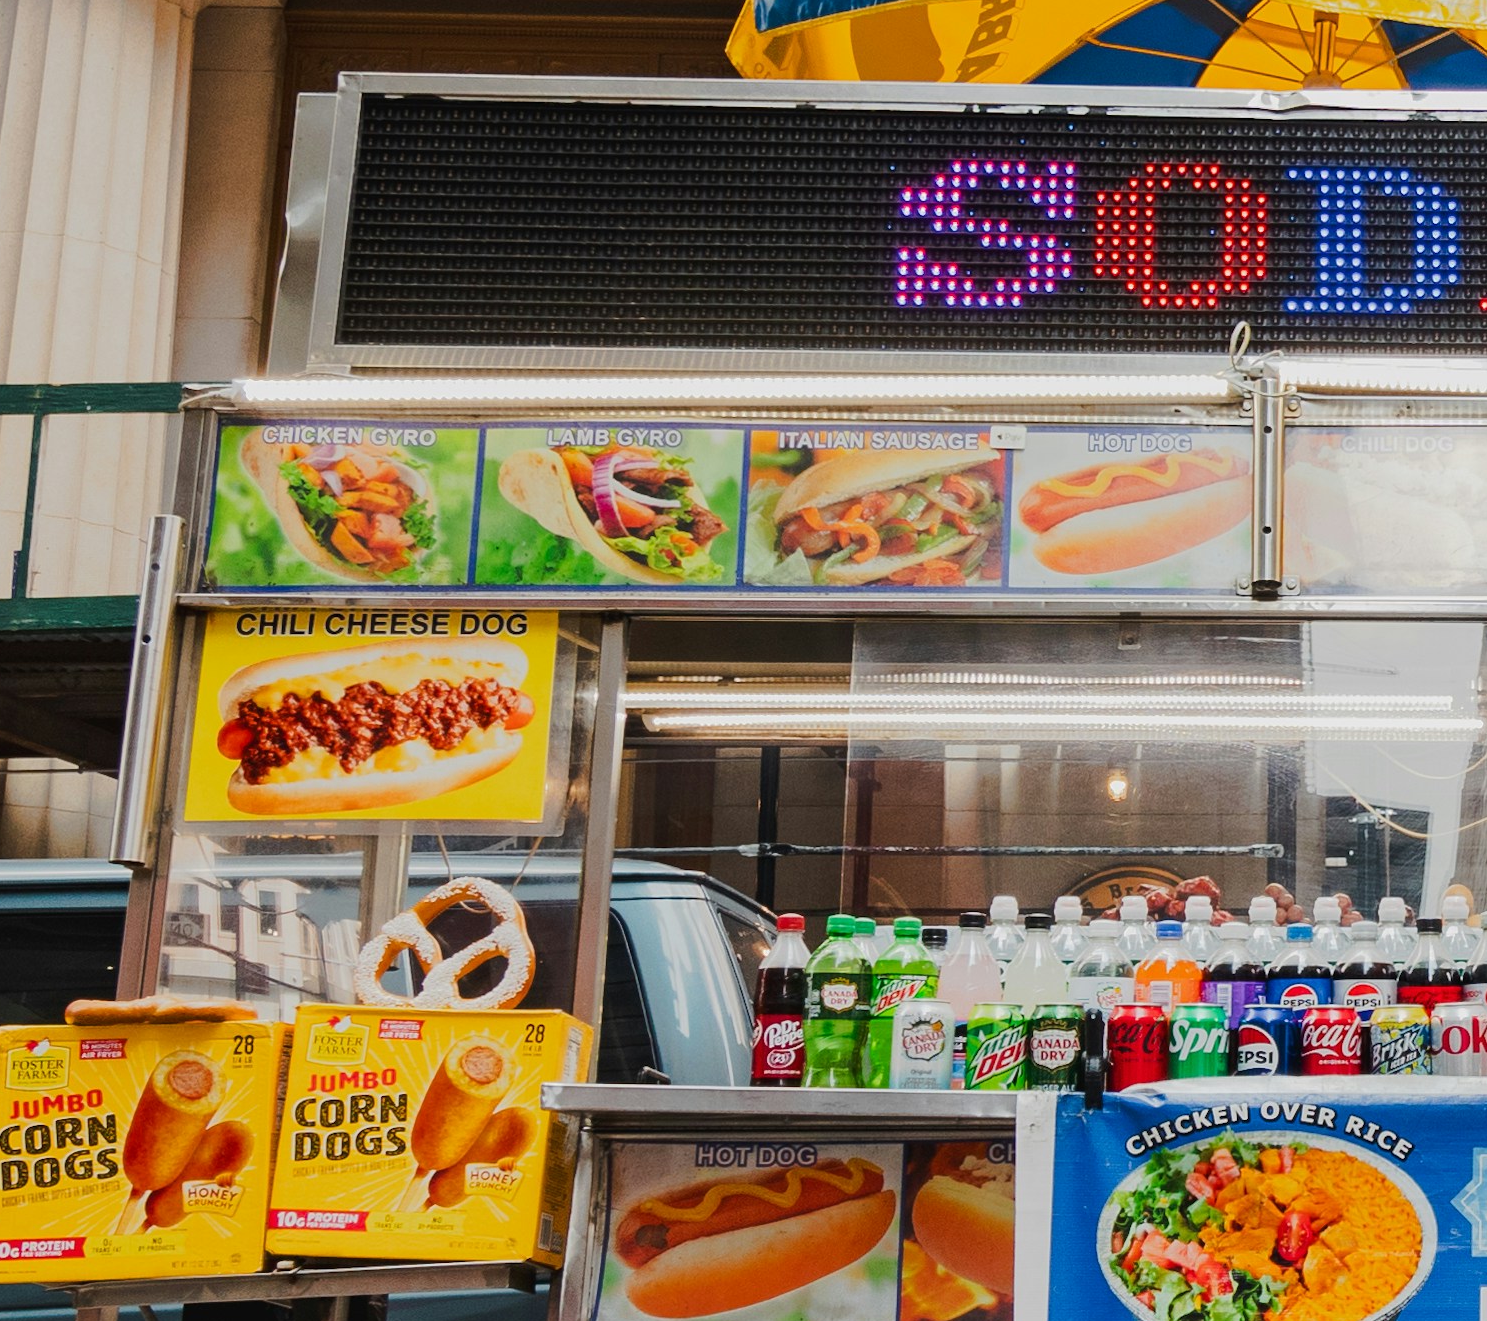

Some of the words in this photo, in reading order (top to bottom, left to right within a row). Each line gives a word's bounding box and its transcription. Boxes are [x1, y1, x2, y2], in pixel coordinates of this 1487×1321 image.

[262, 425, 362, 447] CHICKEN
[370, 426, 437, 448] GYRO
[546, 427, 612, 447] LAMB
[616, 426, 683, 448] GYRO
[778, 431, 864, 450] ITALIAN
[870, 432, 980, 451] SAUSAGE
[1088, 433, 1137, 453] HOT
[1140, 433, 1192, 453] DOG
[1341, 436, 1399, 454] CHILI
[1403, 435, 1455, 454] DOG
[236, 613, 316, 638] CHILI
[323, 612, 451, 637] CHEESE
[459, 613, 530, 638] DOG
[821, 988, 859, 1001] CANADA
[829, 997, 849, 1008] DRY
[524, 1023, 545, 1045] 28
[779, 1020, 801, 1036] Dr
[233, 1034, 255, 1057] 28
[312, 1034, 364, 1047] FOSTER
[902, 1028, 946, 1050] CANADA
[914, 1038, 940, 1056] DRY
[1030, 1036, 1080, 1052] CANADA
[12, 1058, 64, 1071] FOSTER
[1039, 1049, 1068, 1063] DRY
[307, 1068, 397, 1093] JUMBO
[10, 1089, 104, 1120] JUMBO
[293, 1093, 409, 1129] CORN
[1123, 1100, 1251, 1158] CHICKEN
[1259, 1100, 1338, 1131] OVER
[1343, 1115, 1416, 1163] RICE
[293, 1126, 408, 1162] DOGS
[695, 1143, 754, 1168] HOT
[755, 1143, 818, 1168] DOG
[0, 1148, 120, 1192] DOGS
[469, 1171, 518, 1187] HONEY
[187, 1187, 239, 1203] HONEY
[468, 1181, 514, 1194] CRUNCHY
[187, 1198, 235, 1211] CRUNCHY
[306, 1212, 359, 1224] PROTEIN
[21, 1240, 76, 1253] PROTEIN
